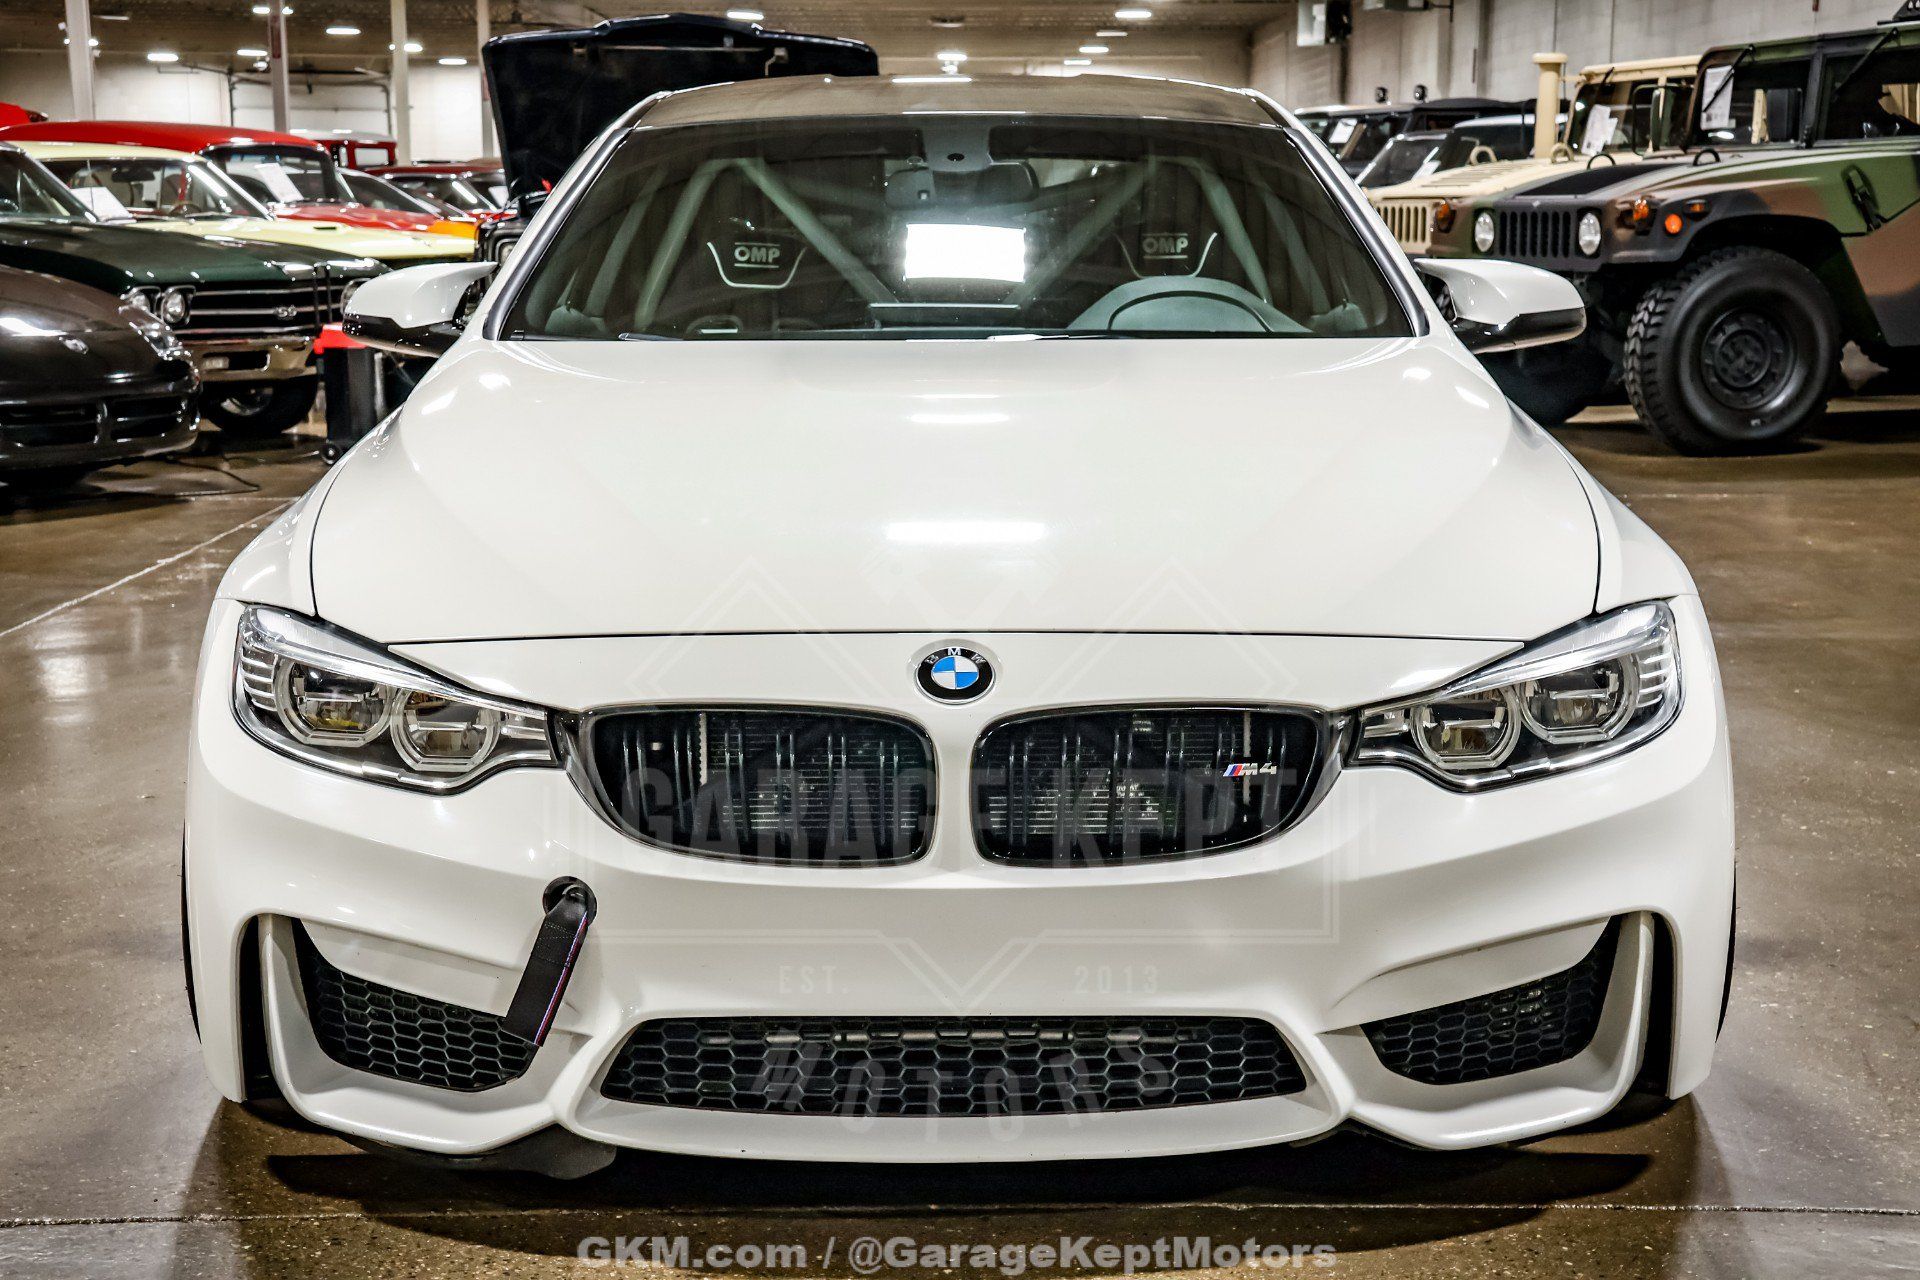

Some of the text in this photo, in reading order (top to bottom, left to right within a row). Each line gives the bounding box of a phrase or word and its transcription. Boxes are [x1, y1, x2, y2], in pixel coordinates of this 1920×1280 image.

[1142, 237, 1189, 254] OMP
[734, 246, 780, 263] OMP
[924, 647, 987, 665] BMW
[1231, 762, 1277, 776] M4
